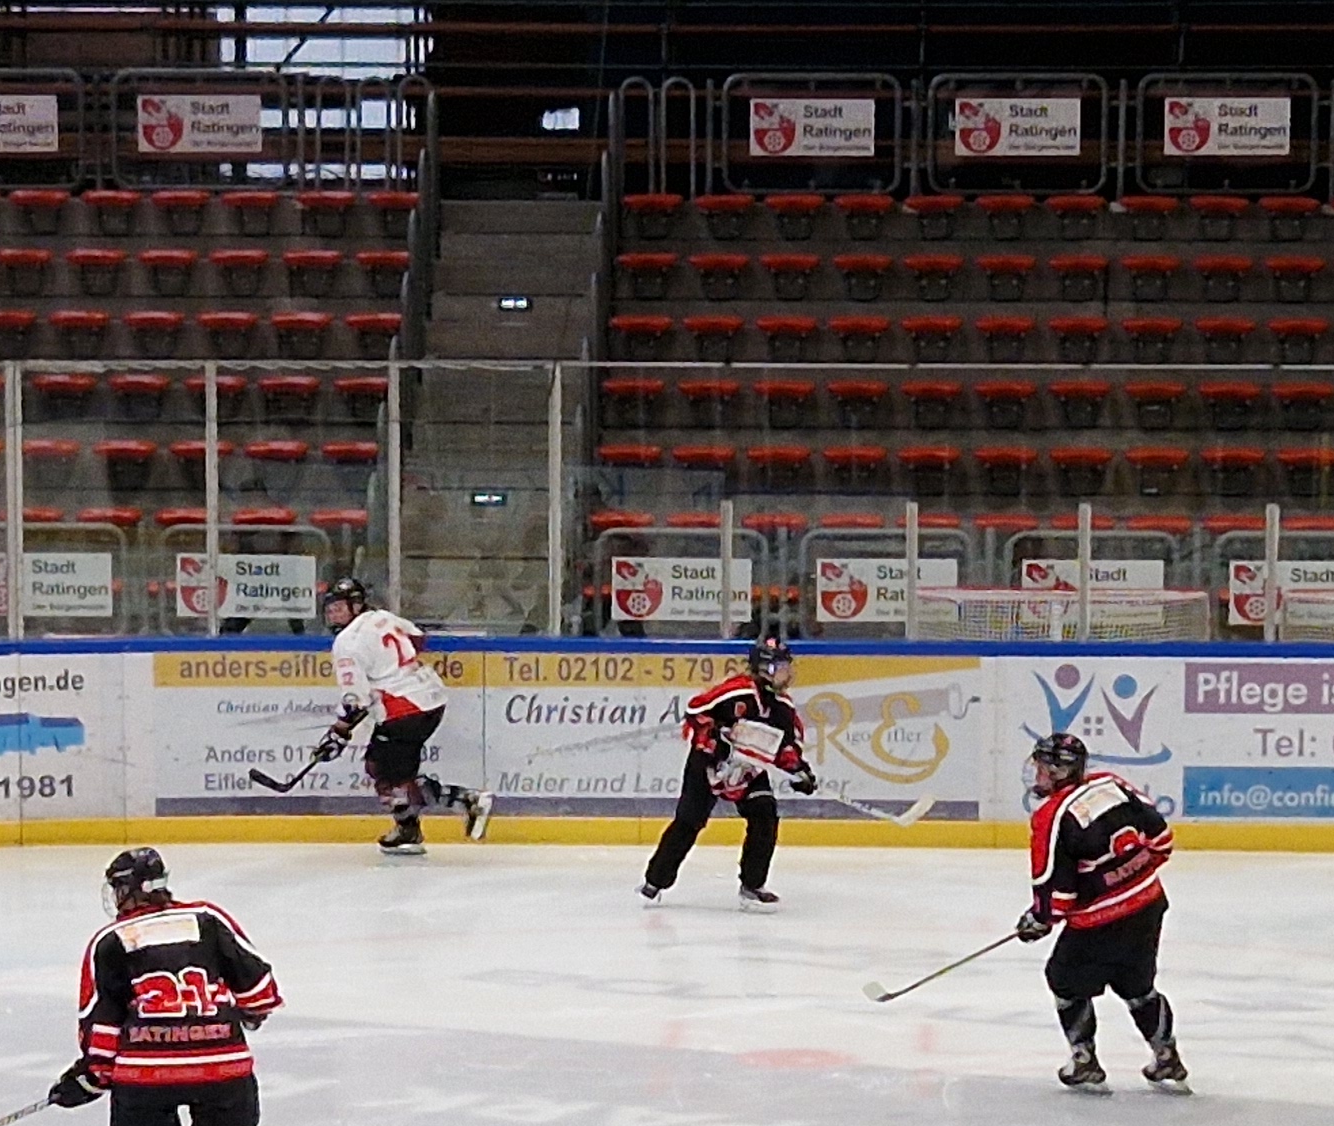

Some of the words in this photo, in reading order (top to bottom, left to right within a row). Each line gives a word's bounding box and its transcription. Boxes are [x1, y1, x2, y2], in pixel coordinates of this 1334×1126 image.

[190, 102, 231, 116] Stadt
[802, 104, 844, 118] Stadt
[1008, 104, 1049, 118] Stadt
[1217, 104, 1259, 118] Stadt
[190, 121, 259, 137] Ratingen
[802, 124, 872, 140] Ratingen
[1008, 124, 1078, 140] Ratingen
[1216, 123, 1288, 139] Ratingen
[31, 559, 77, 574] Stadt
[235, 561, 280, 575] Stadt
[671, 565, 717, 579] Stadt
[875, 566, 922, 581] Stat
[31, 582, 109, 600] Ratingen
[235, 584, 313, 601] Ratingen
[506, 656, 547, 682] Tel.
[557, 656, 634, 682] 02102
[662, 657, 676, 682] 5
[684, 657, 715, 682] 79
[1196, 670, 1308, 712] Pflege
[216, 700, 278, 715] Christian
[505, 693, 648, 726] Christian
[1252, 727, 1317, 758] Tel:
[205, 745, 276, 764] Anders
[497, 770, 568, 795] Maler
[576, 772, 627, 795] und
[130, 965, 219, 1018] 21
